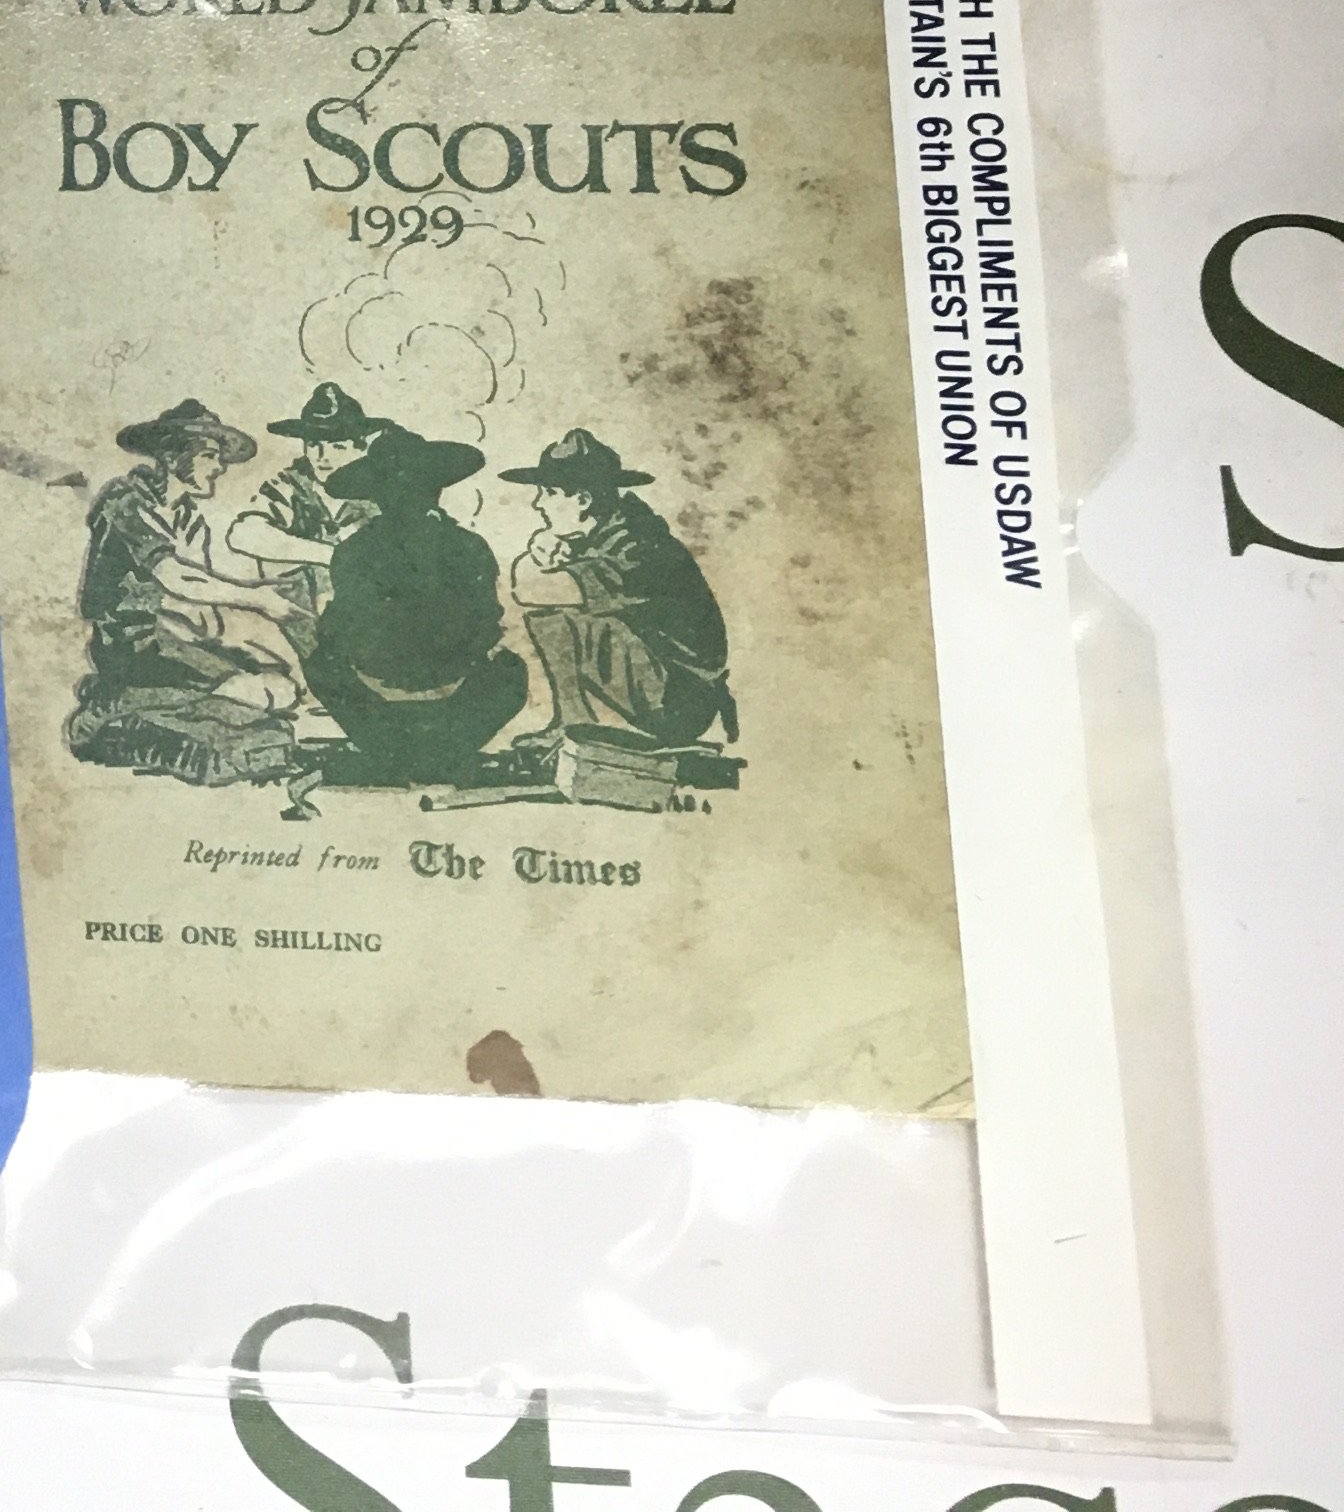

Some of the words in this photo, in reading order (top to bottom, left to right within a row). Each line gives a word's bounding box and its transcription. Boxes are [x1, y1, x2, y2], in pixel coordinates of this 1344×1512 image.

[322, 18, 451, 115] of
[960, 31, 1002, 99] THE
[916, 116, 957, 172] 6th
[346, 204, 465, 249] 1929
[966, 112, 1025, 376] COMPLIMENTS
[921, 184, 970, 341] BIGGEST
[934, 349, 979, 467] UNION
[988, 390, 1029, 441] OF
[992, 454, 1043, 590] USDAW
[183, 839, 303, 876] Reprinted
[316, 844, 381, 874] from
[409, 839, 485, 882] The
[512, 845, 644, 888] Times
[84, 920, 164, 944] PRICE
[180, 924, 238, 949] ONE
[254, 927, 384, 954] SHILLING
